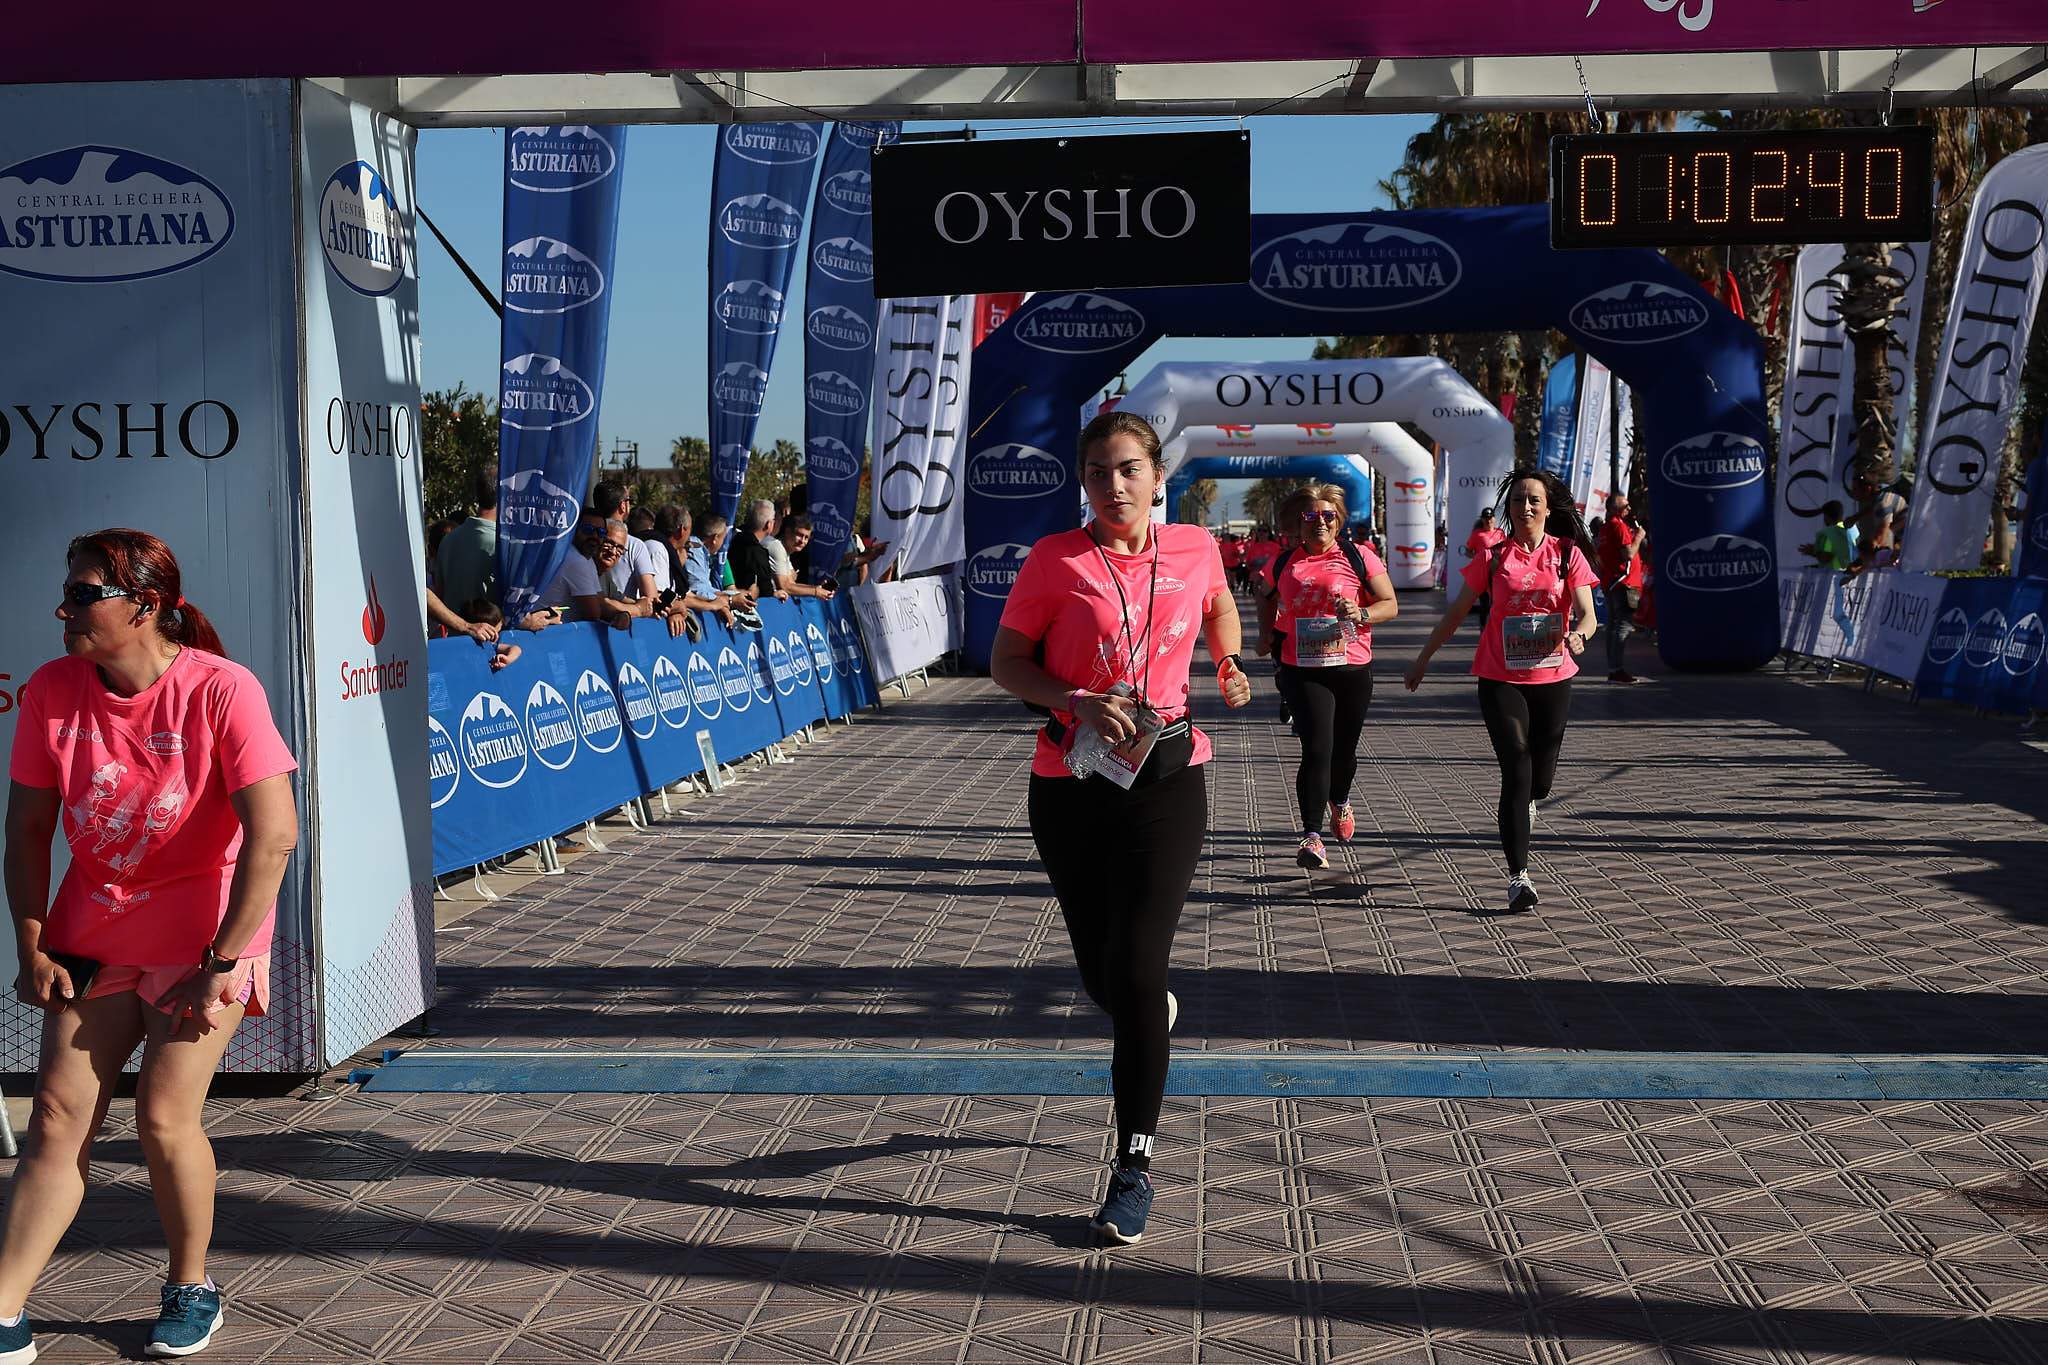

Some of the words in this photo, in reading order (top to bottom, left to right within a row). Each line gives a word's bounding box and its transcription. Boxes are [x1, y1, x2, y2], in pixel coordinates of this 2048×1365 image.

[732, 125, 812, 155] ASTURIANA
[17, 194, 105, 208] CENTRAL
[114, 191, 203, 206] LECHERA
[726, 210, 797, 239] ASTURIANA
[934, 186, 1196, 244] OYSHO
[327, 200, 403, 269] ASTURIANA
[1296, 249, 1361, 260] CENTRAL
[1369, 247, 1441, 258] LECHERA
[506, 273, 591, 296] STURIANA
[1262, 251, 1448, 289] ASTURIANA
[812, 315, 866, 344] ASTURIANA
[1022, 317, 1136, 338] ASTURIANA
[1581, 307, 1700, 330] ASTURIANA
[1927, 199, 2045, 496] OYSHO
[1216, 371, 1384, 408] OYSHO
[1432, 407, 1484, 418] OYSHO
[0, 400, 240, 461] YSHO
[327, 397, 411, 459] OYSHO
[972, 464, 1060, 485] ASTURIANA
[1669, 455, 1763, 476] ASTURIANA
[971, 564, 1018, 584] ASTUR
[1673, 556, 1767, 578] ASTURIANA
[1881, 588, 1929, 637] OYSHO
[341, 658, 409, 701] Santander
[578, 704, 621, 736] ASTURIANA
[622, 693, 656, 721] ASTURIANA
[473, 726, 496, 738] CENTRAL
[530, 716, 575, 751] ASTURIANA
[466, 732, 526, 769] ASTURIANA
[1108, 751, 1133, 770] VALENCIA
